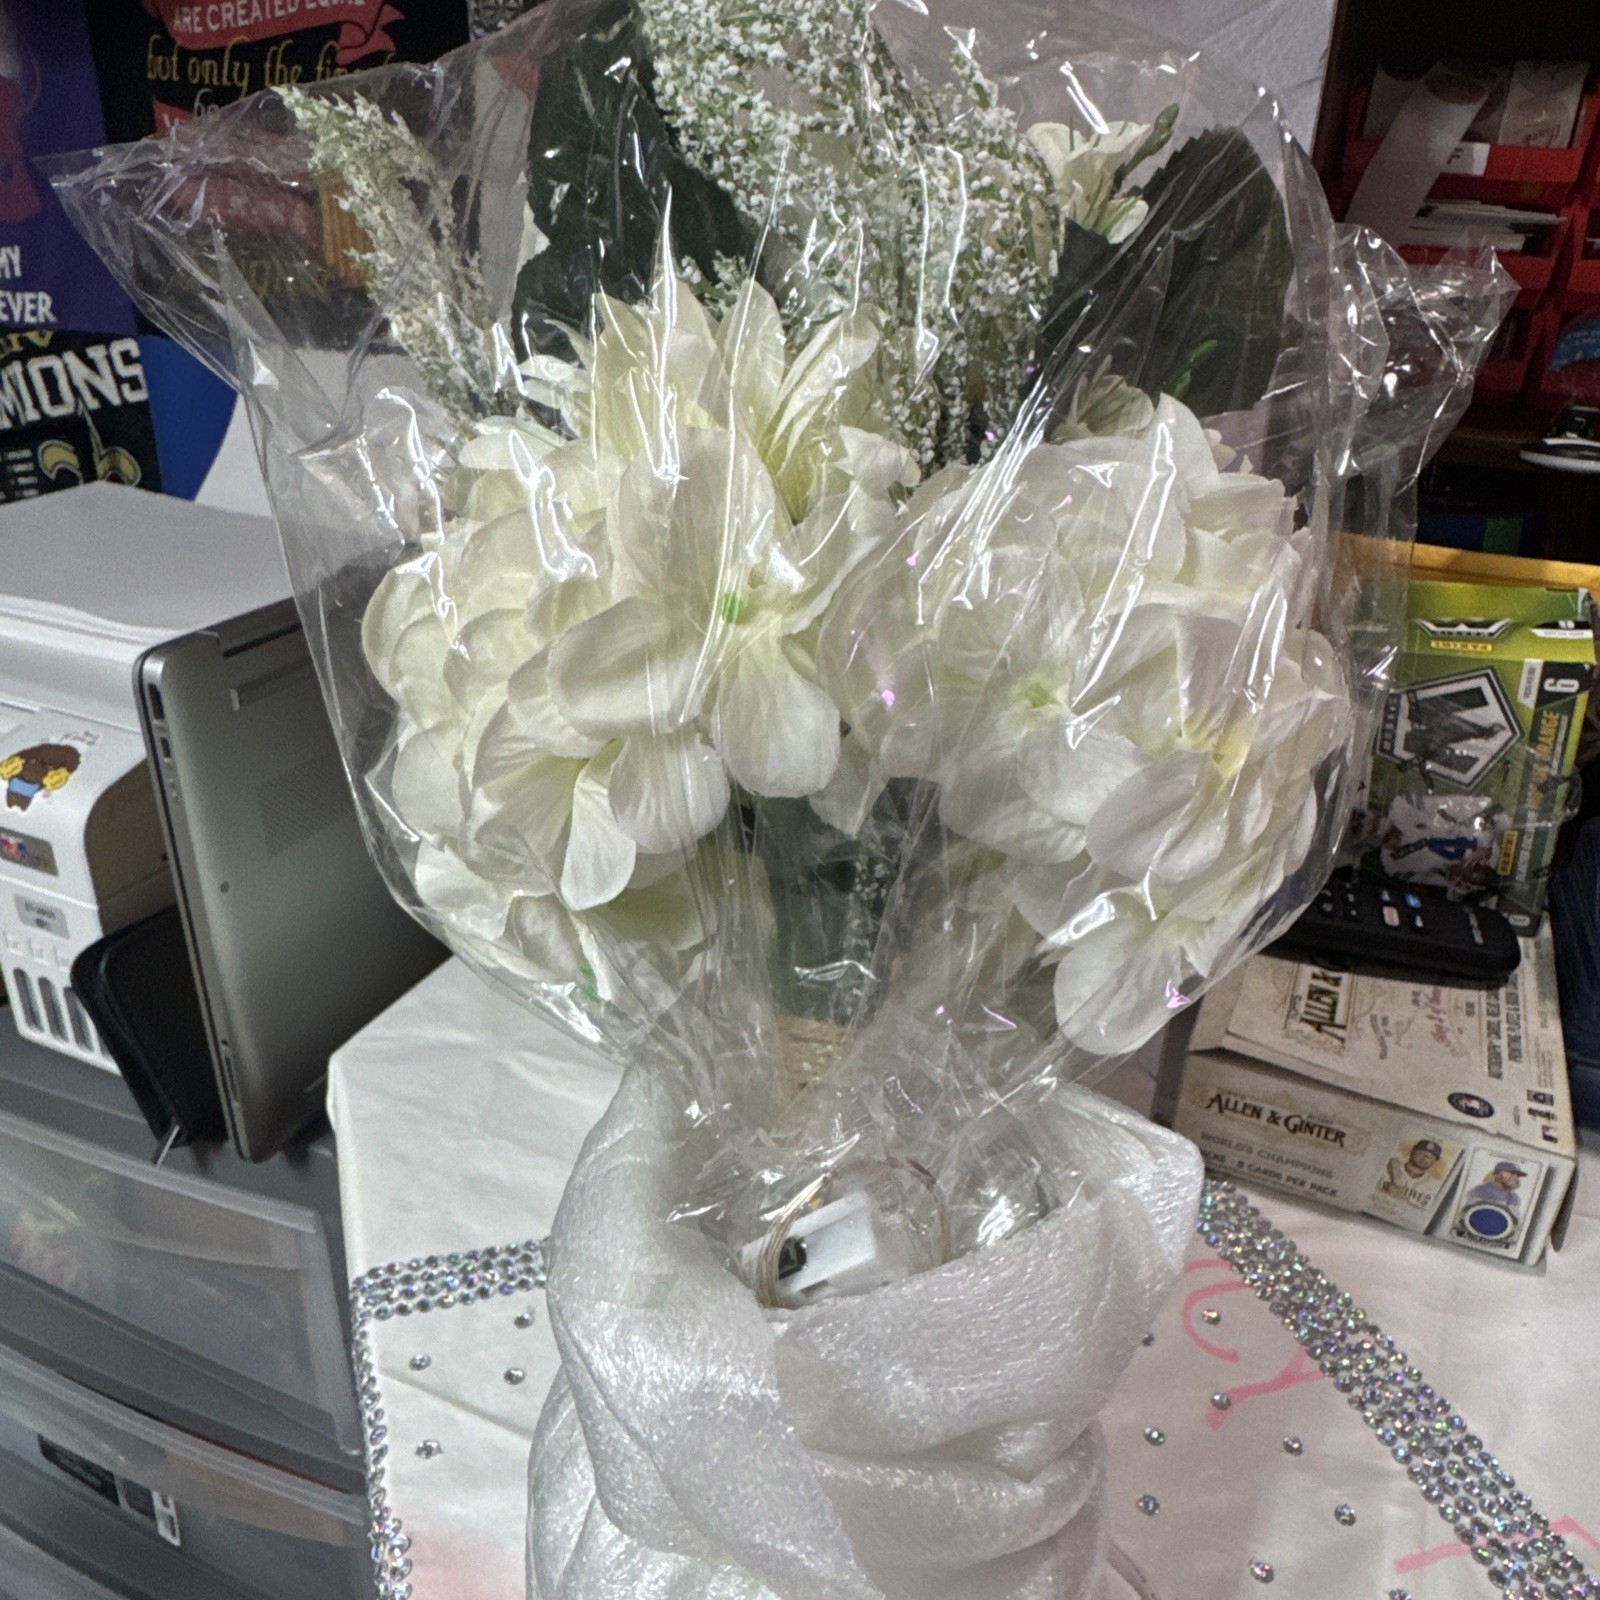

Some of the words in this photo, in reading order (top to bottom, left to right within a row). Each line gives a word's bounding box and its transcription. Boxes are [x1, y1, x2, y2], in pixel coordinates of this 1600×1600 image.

[173, 7, 203, 33] ARE
[206, 0, 299, 31] CREATED
[147, 34, 180, 82] but
[187, 35, 251, 98] only
[263, 40, 302, 87] the
[1543, 678, 1580, 693] 6
[1300, 983, 1346, 1043] ALLEN
[1205, 1092, 1263, 1121] ALLEN
[1266, 1110, 1282, 1126] &
[1283, 1114, 1347, 1148] GINTER
[1258, 1149, 1334, 1179] CHAMPIONS
[1286, 1175, 1307, 1188] PER
[1309, 1181, 1339, 1198] PACK
